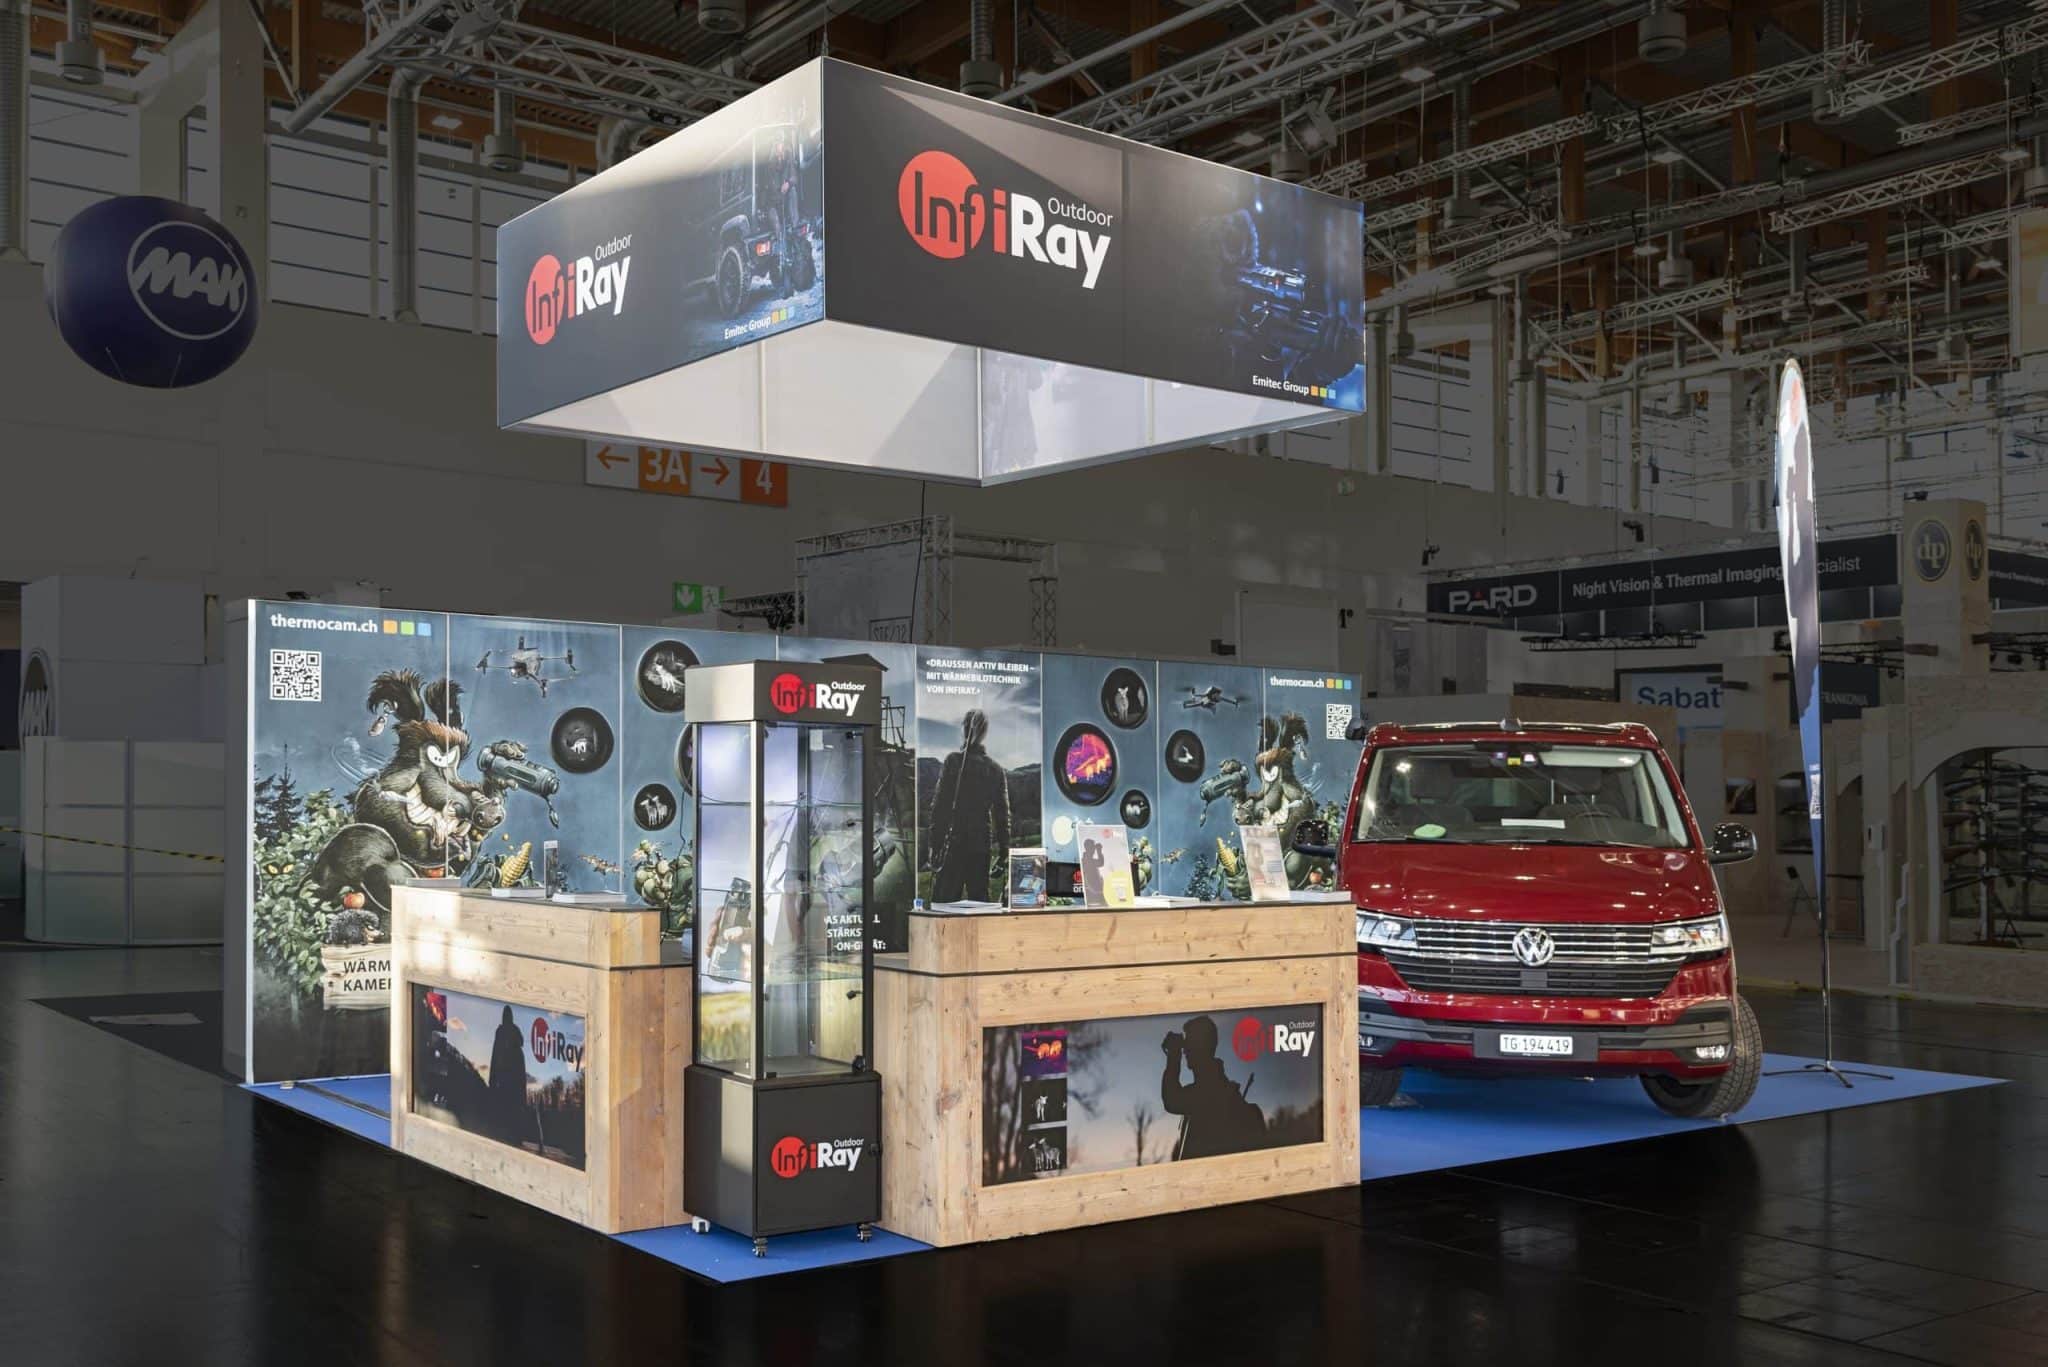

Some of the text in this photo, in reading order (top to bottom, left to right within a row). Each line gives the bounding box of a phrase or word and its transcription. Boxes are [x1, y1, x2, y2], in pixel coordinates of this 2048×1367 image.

[1047, 196, 1113, 227] Outdoor
[594, 232, 632, 261] Outdoor
[724, 316, 771, 340] Emitec Group
[1252, 375, 1310, 396] Emitec Group
[644, 448, 773, 495] 3A 4
[1572, 556, 1861, 599] Night Vision & Thermal Imaging cialist
[1448, 583, 1538, 613] PARD
[270, 613, 378, 634] thermocam.ch
[926, 671, 942, 681] MIT
[973, 661, 996, 670] AKTIV
[998, 663, 1029, 672] BLEIBEN
[831, 681, 866, 691] Outdoor
[926, 685, 944, 694] VON
[1270, 675, 1325, 689] thermocam.ch
[1638, 685, 1723, 709] Sabat
[343, 957, 391, 973] WÄRM
[833, 1137, 865, 1149] Outdoor
